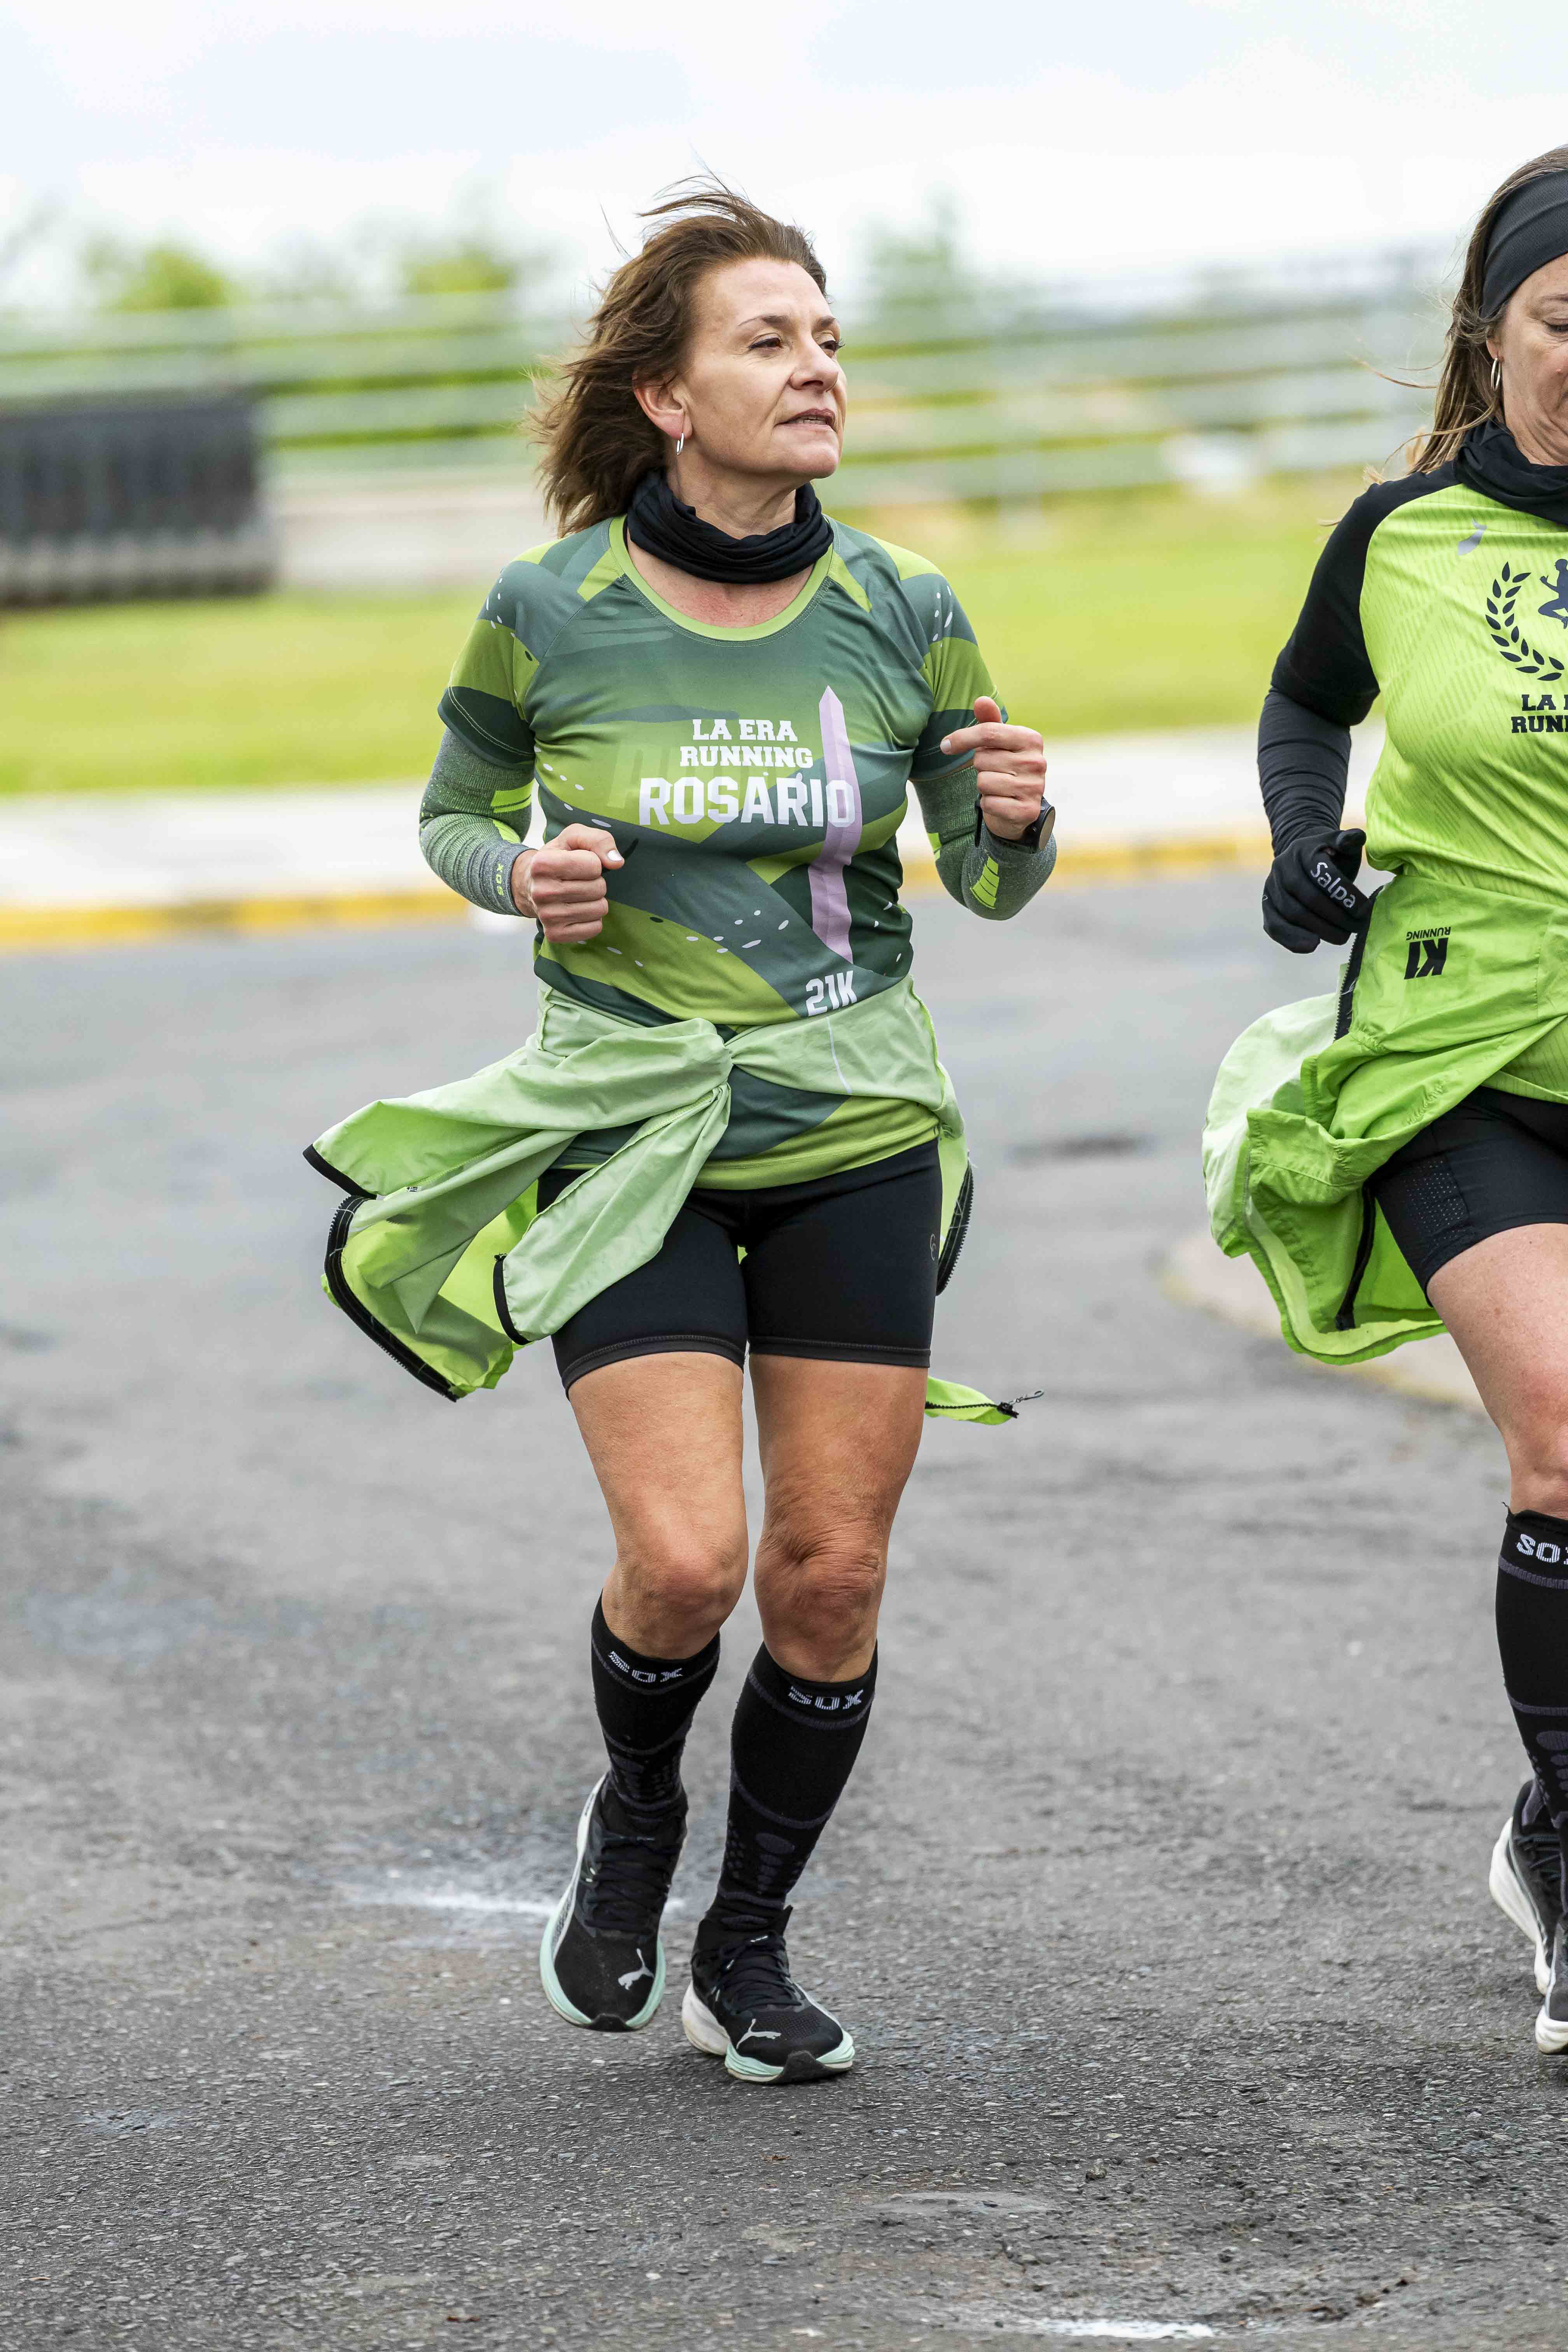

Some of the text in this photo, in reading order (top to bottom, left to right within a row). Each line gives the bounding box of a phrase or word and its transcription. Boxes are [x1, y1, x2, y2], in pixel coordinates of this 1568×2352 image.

[1521, 694, 1556, 711] LA
[692, 719, 798, 742] LA ERA
[1511, 715, 1568, 733] RUN
[680, 746, 813, 769] RUNNING
[639, 776, 856, 828] ROSARIO
[1310, 862, 1356, 908] Salpa
[1406, 926, 1451, 941] RUNNING
[805, 970, 857, 1017] 21K
[1516, 1534, 1568, 1565] SO
[608, 1651, 683, 1682] SOX
